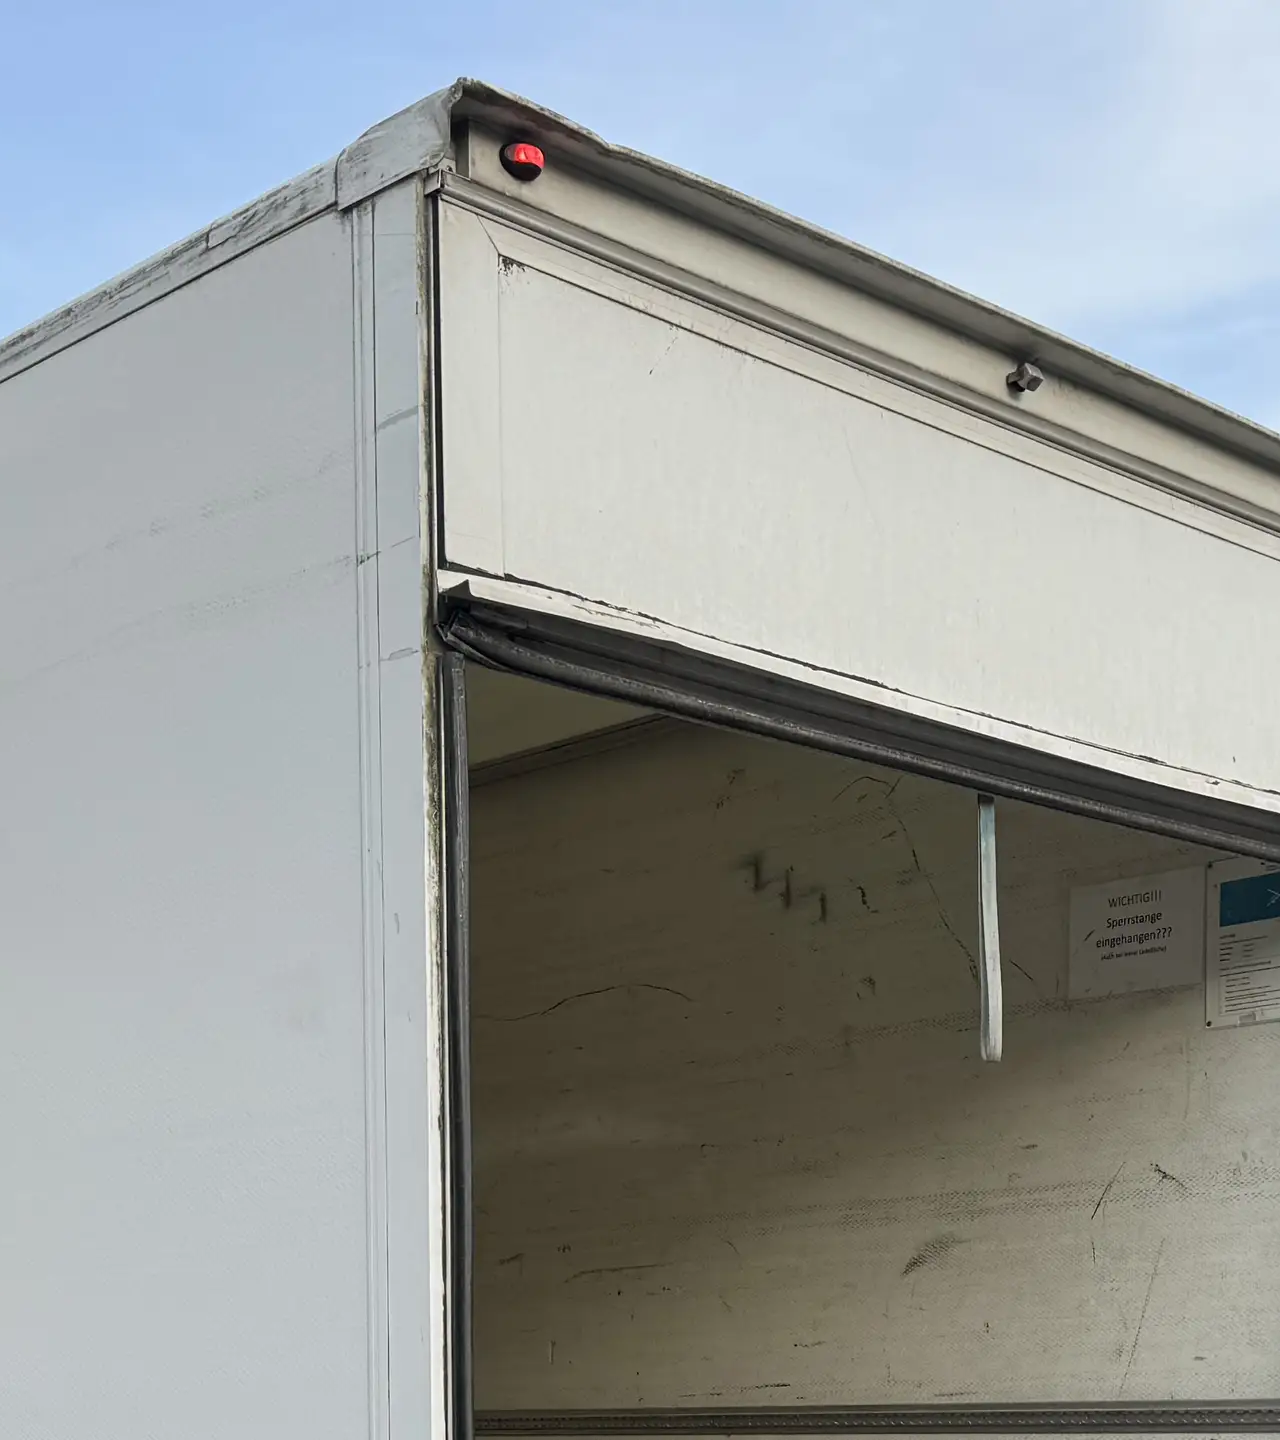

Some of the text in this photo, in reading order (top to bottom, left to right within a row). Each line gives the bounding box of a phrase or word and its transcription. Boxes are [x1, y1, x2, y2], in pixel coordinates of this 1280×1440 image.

[1108, 889, 1162, 908] WICHTIG!!!
[1106, 912, 1163, 929] Sperrstange
[1096, 926, 1173, 948] eingehangen???
